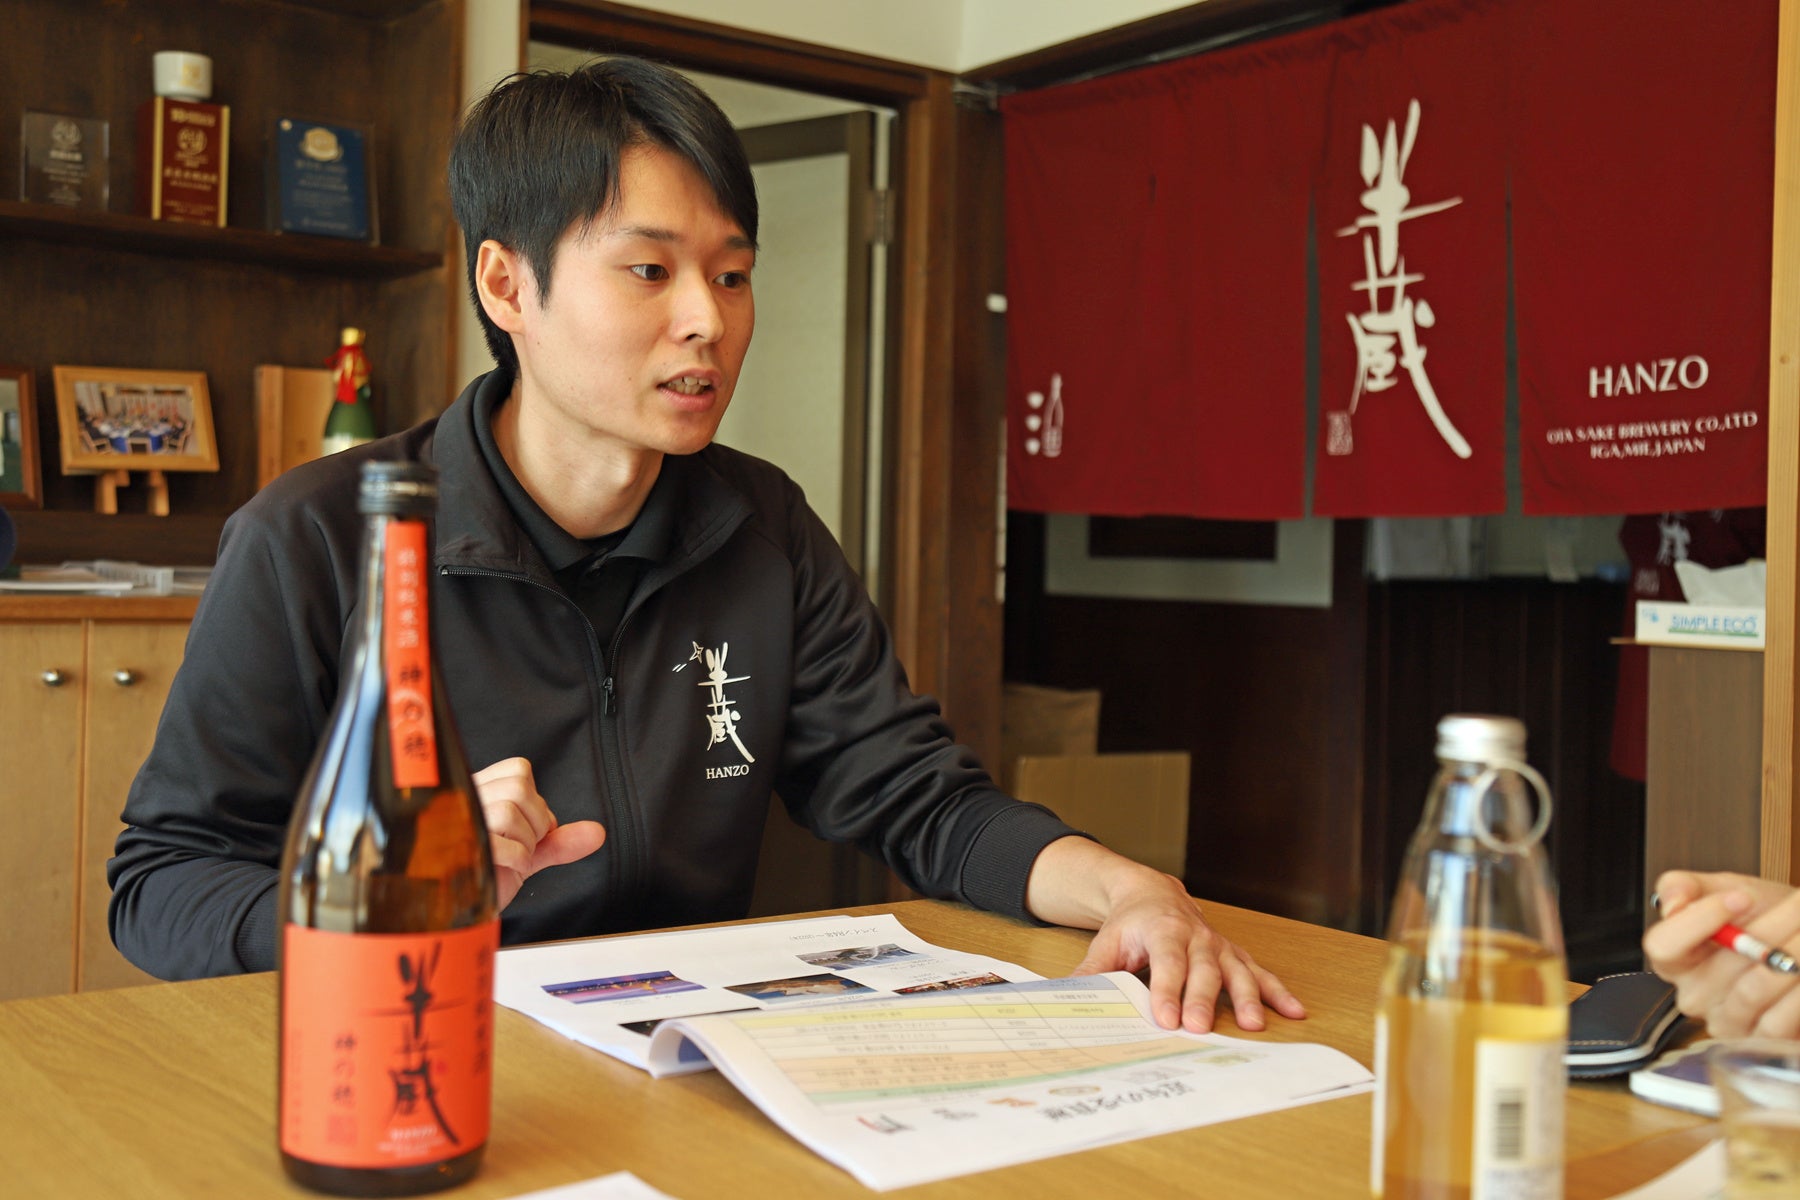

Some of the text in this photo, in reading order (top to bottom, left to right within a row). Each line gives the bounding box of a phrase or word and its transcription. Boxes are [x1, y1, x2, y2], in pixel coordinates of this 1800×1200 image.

[1588, 354, 1709, 398] HANZO
[1576, 423, 1615, 443] SAKE
[1618, 418, 1692, 439] BREWERY
[1671, 614, 1719, 631] SIMPLE
[705, 764, 750, 780] HANZO
